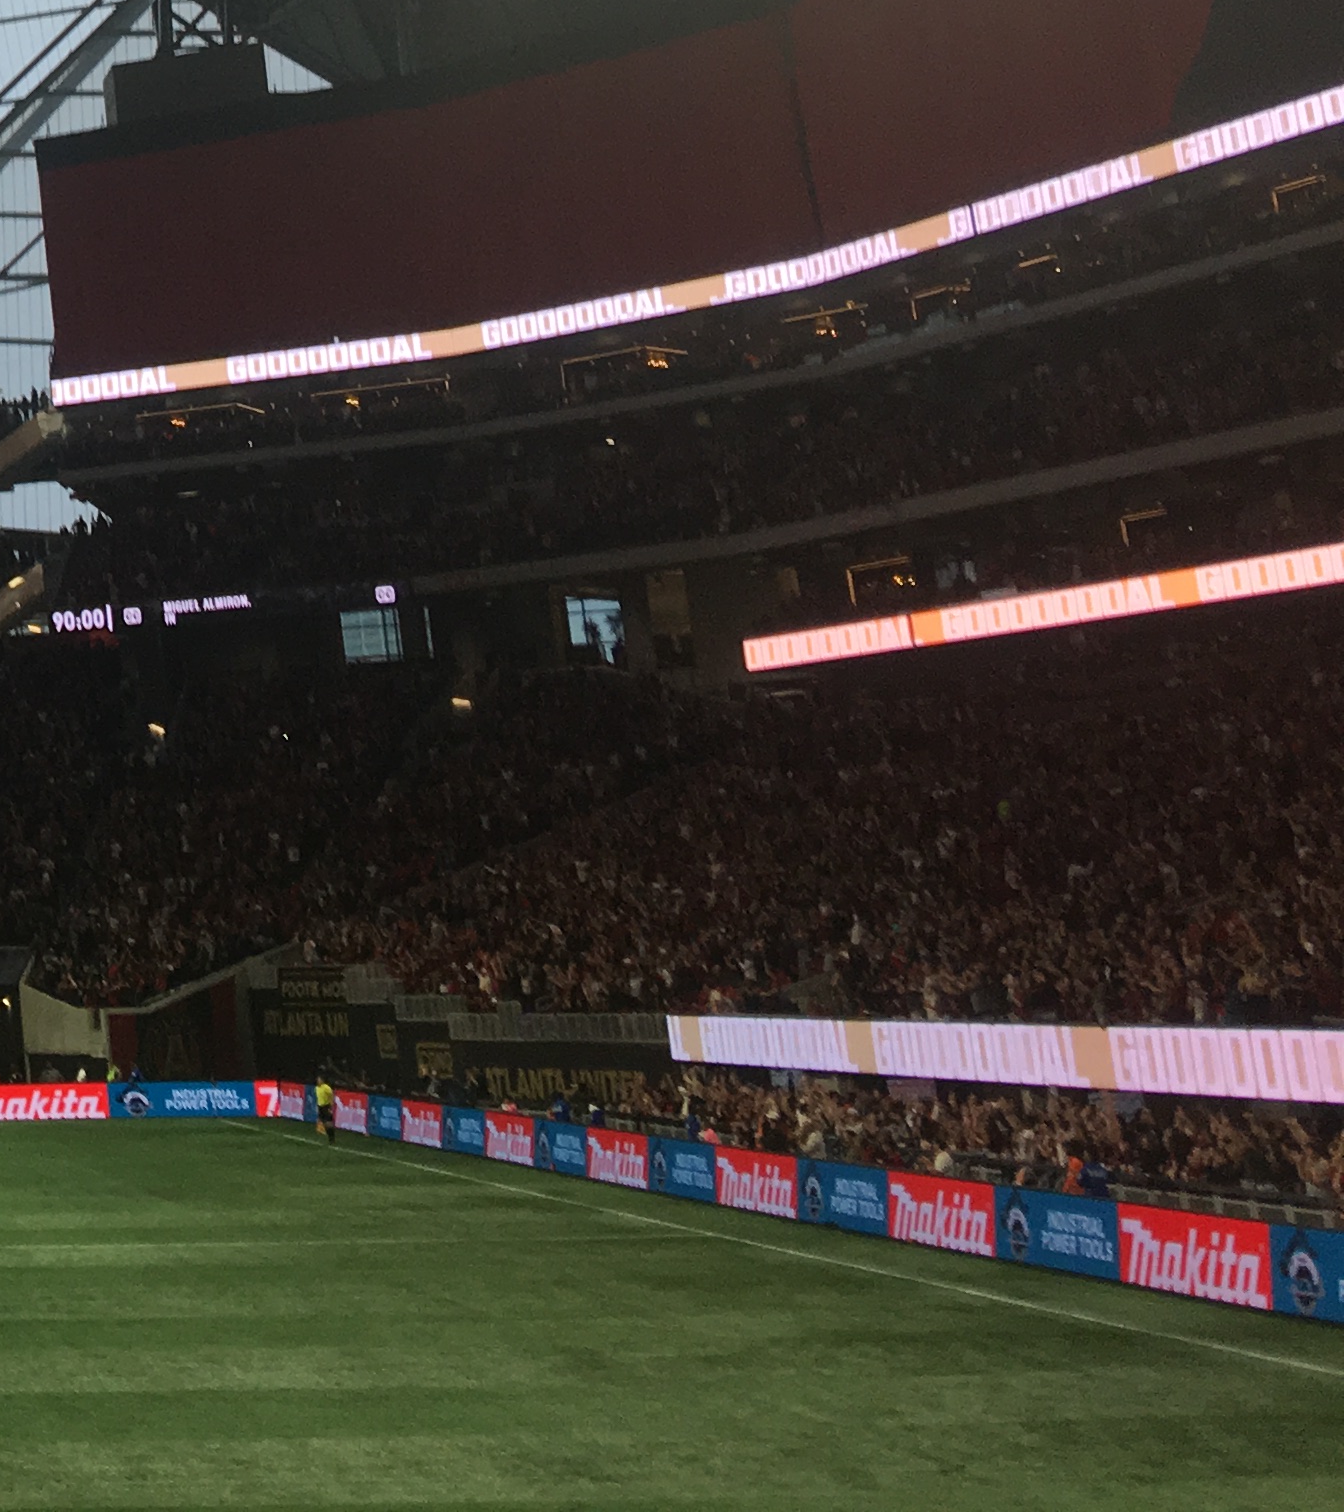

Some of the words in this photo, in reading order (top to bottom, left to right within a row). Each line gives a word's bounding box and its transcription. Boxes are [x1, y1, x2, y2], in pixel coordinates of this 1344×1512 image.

[52, 607, 105, 633] 90:00
[172, 1089, 239, 1100] INDUSTRIAL
[165, 1099, 208, 1111] POWER
[211, 1098, 249, 1110] TOOLS
